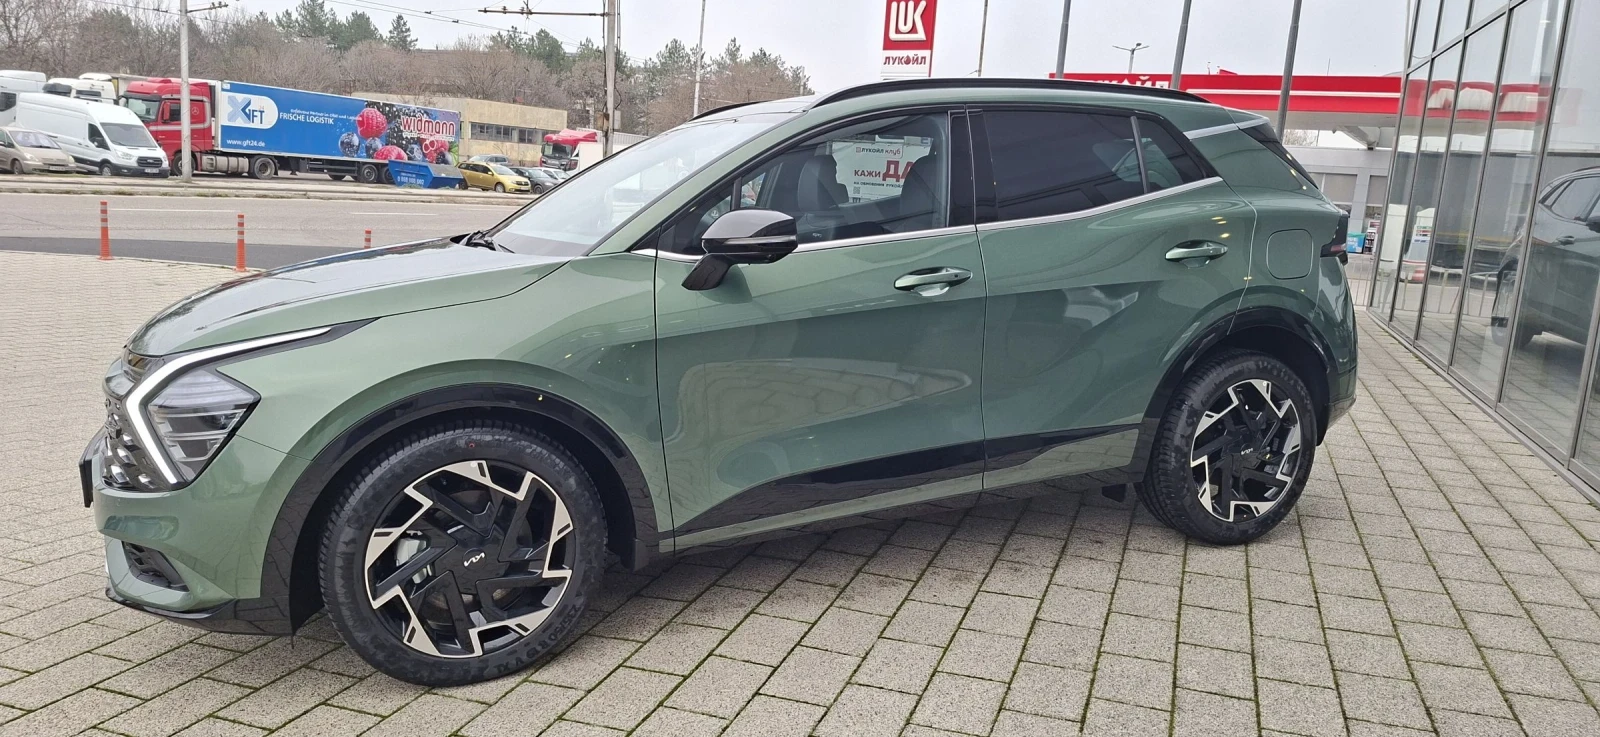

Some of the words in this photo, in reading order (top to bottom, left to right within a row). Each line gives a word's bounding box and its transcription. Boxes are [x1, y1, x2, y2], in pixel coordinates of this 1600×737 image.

[883, 53, 927, 65] ЛУКОЙЛ
[280, 112, 305, 122] FRISCHE
[306, 115, 335, 125] LOGISTIK
[401, 113, 456, 136] widmann
[226, 138, 266, 148] www.gft24.de
[861, 146, 884, 154] ЛУКОЙЛ
[884, 148, 900, 156] клуб
[854, 169, 881, 178] КАЖИ
